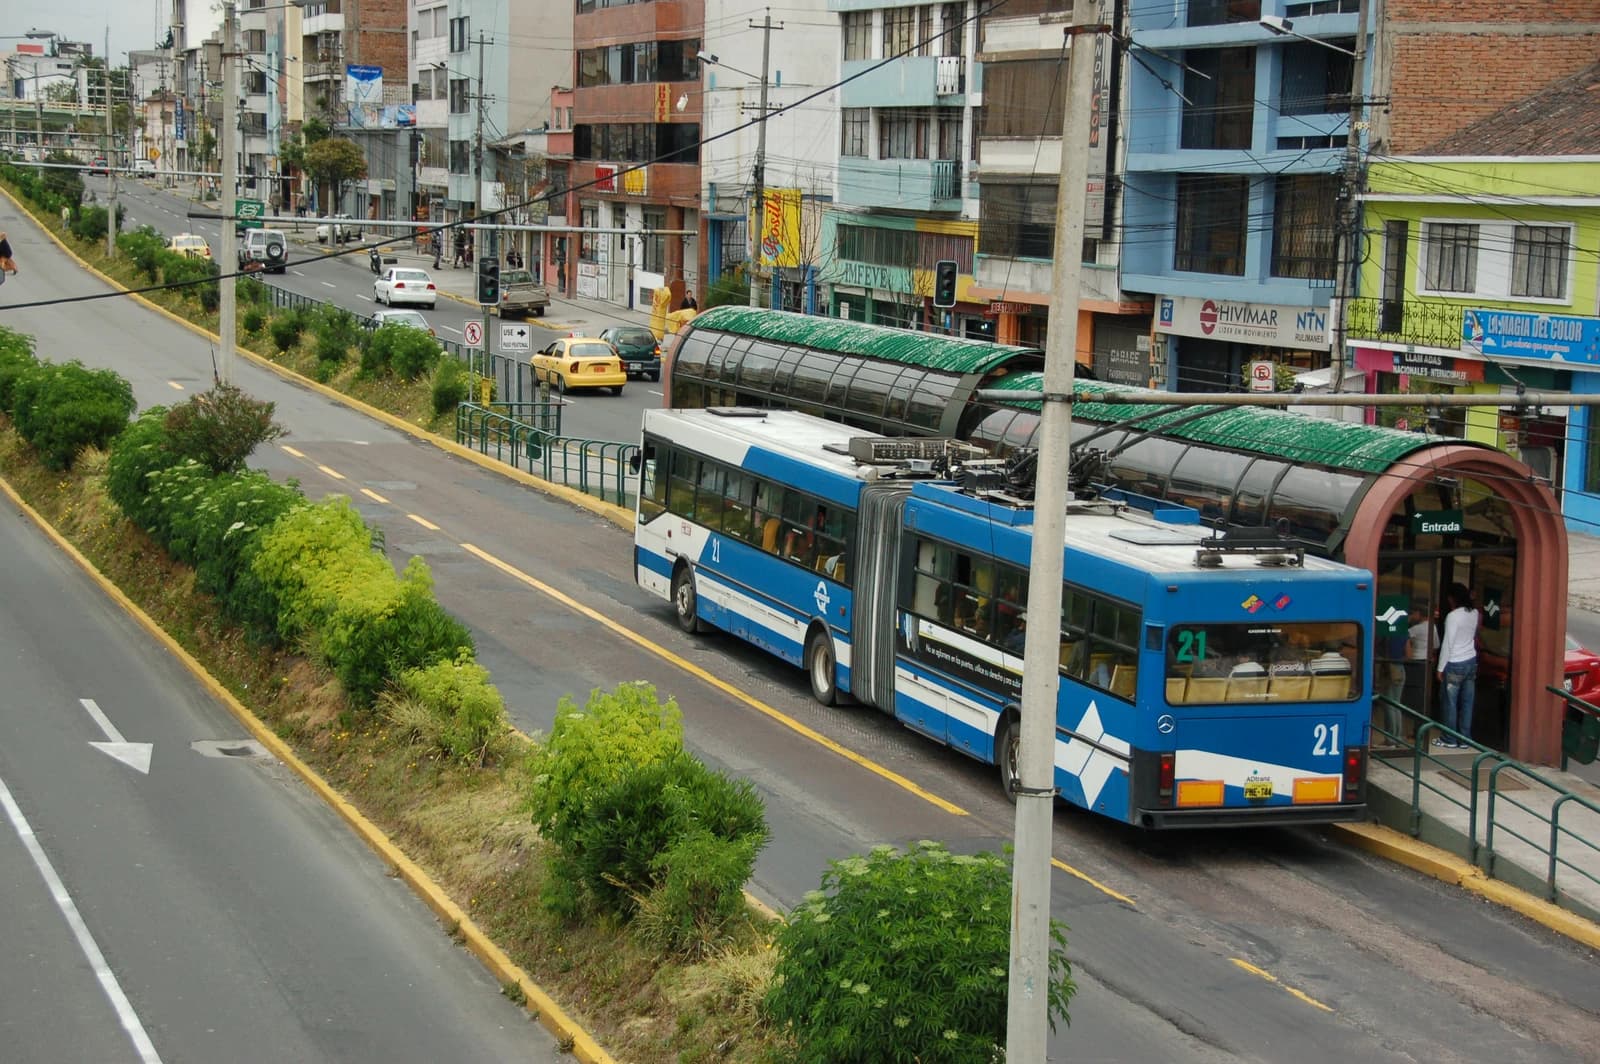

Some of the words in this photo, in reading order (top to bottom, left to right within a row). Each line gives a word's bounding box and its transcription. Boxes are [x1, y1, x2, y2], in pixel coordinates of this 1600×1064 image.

[1219, 304, 1278, 326] HIVIMAR
[1297, 309, 1326, 332] NTN
[503, 328, 514, 337] USE
[1500, 316, 1530, 337] MAGIA
[1532, 318, 1549, 339] DEL
[1550, 319, 1582, 342] COLOR
[1422, 522, 1460, 532] Entrada
[712, 538, 720, 563] 21
[1176, 630, 1207, 662] 21
[1312, 723, 1340, 756] 21
